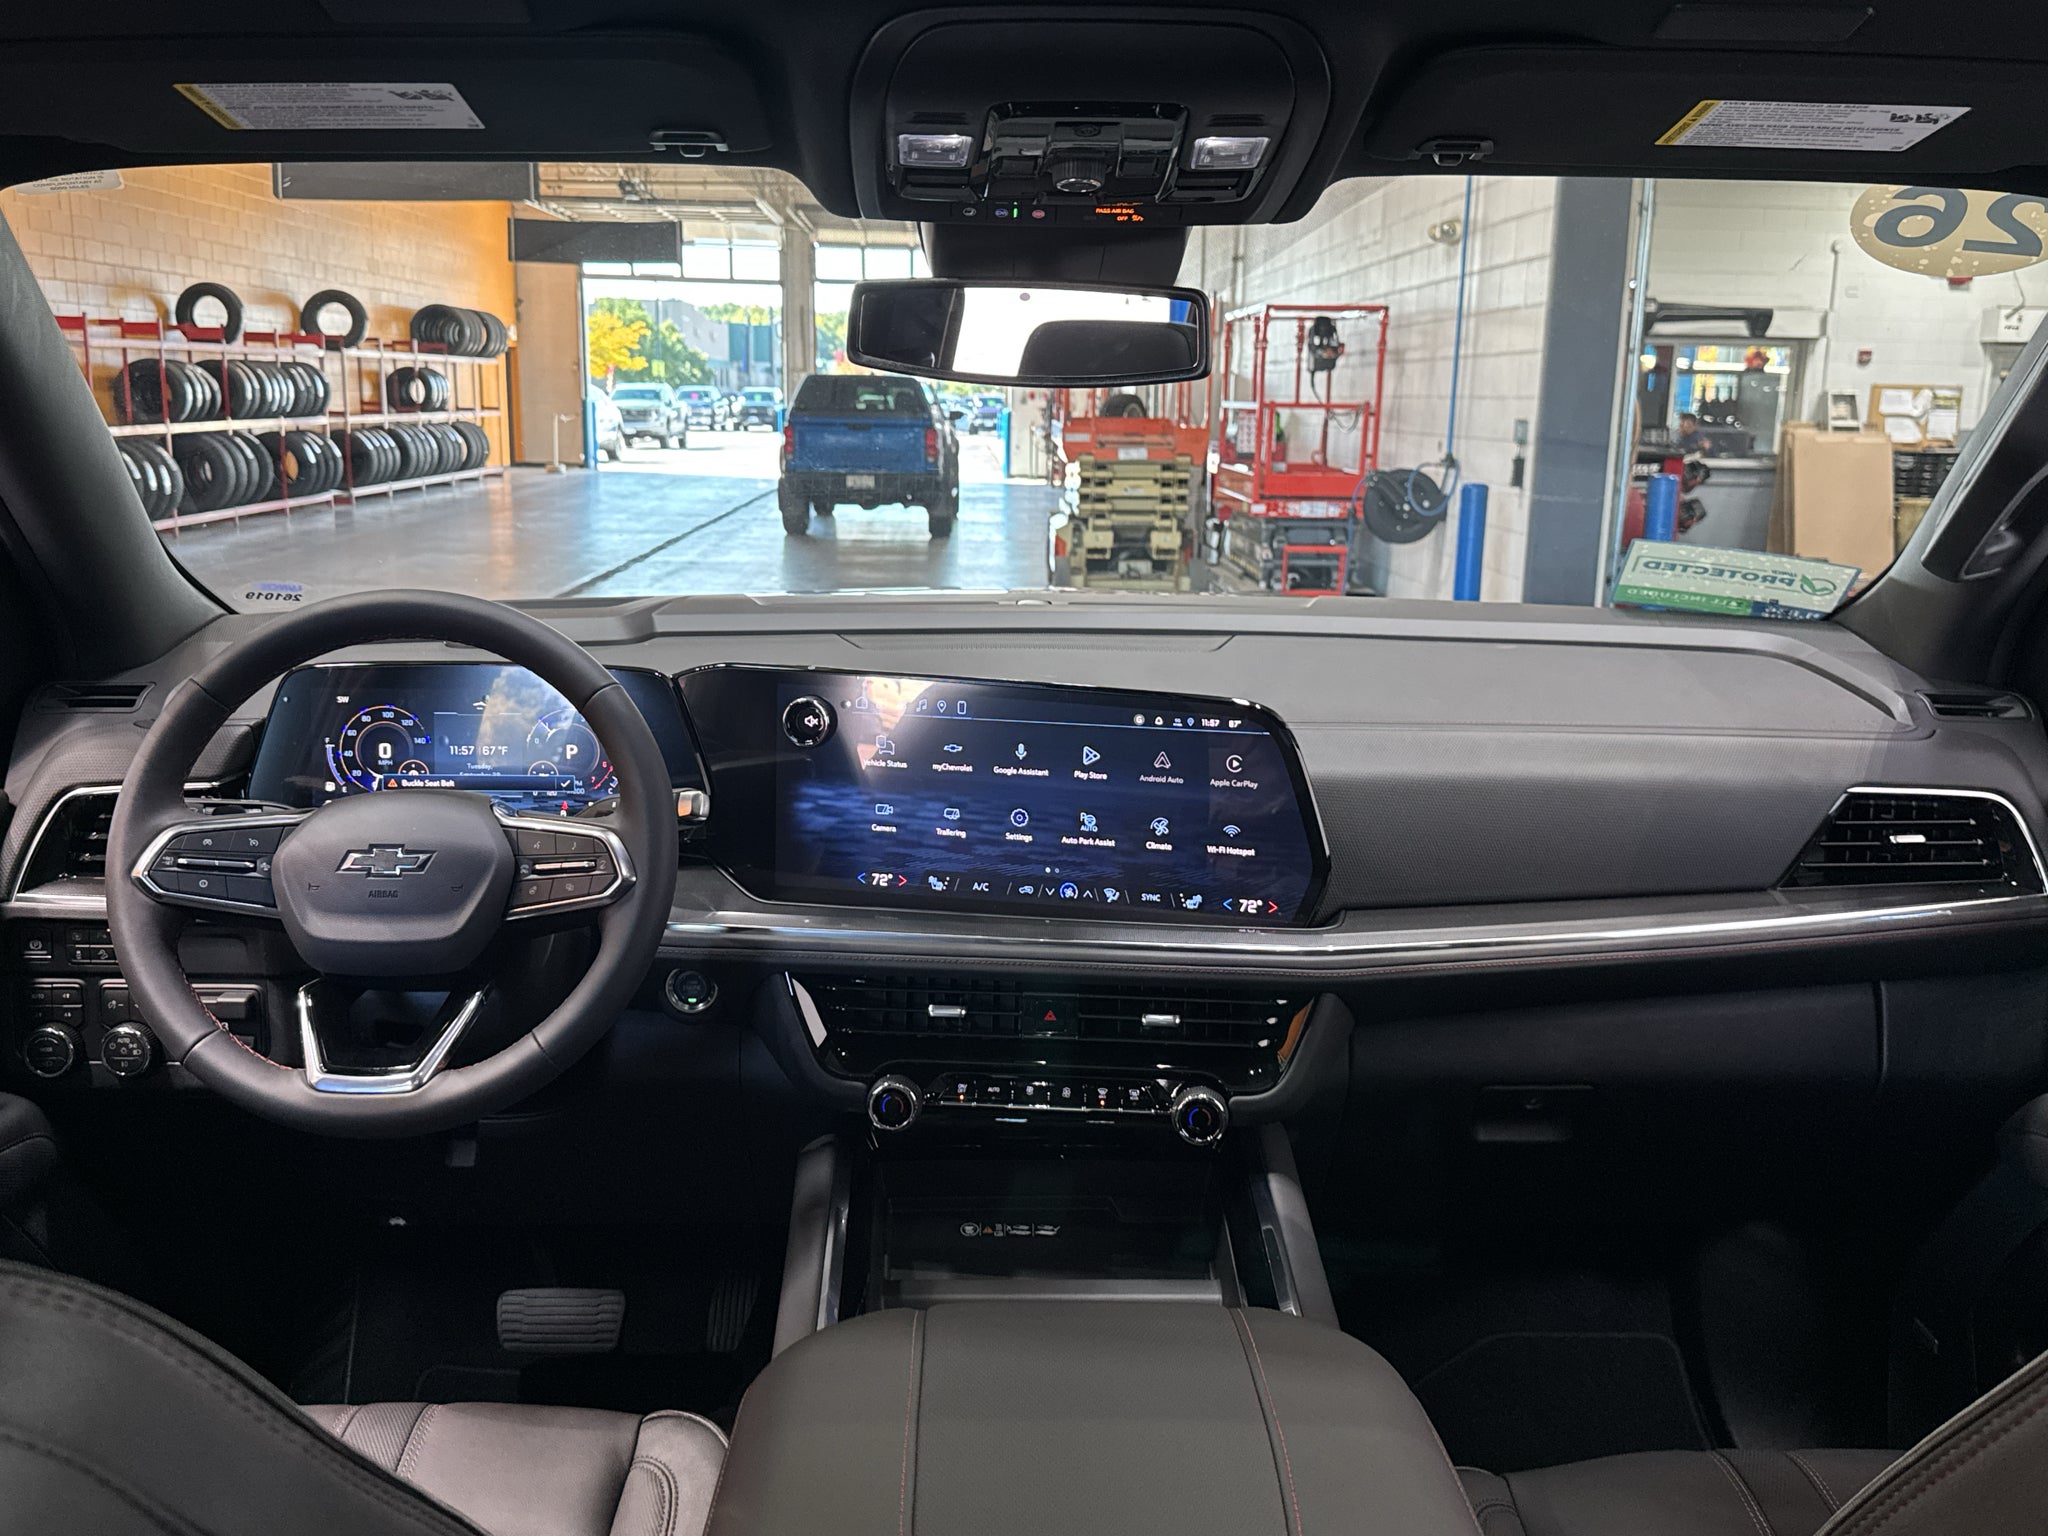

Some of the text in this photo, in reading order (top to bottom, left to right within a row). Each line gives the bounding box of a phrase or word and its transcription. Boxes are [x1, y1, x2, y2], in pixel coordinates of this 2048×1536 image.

[1202, 718, 1220, 727] 11:57
[378, 743, 392, 759] 0
[449, 745, 475, 756] 11:57
[482, 745, 496, 756] 67
[566, 744, 578, 760] P
[863, 759, 908, 769] Vehicle Status
[932, 763, 973, 773] myChevrolet
[993, 765, 1049, 777] Google Assistant
[1074, 770, 1108, 781] Play Store
[401, 779, 455, 788] Buckle Seat Belt
[1139, 774, 1184, 784] Android Auto
[1210, 778, 1258, 790] Apple CarPlay
[871, 823, 897, 833] Camera
[935, 827, 967, 839] Trailering
[1005, 832, 1033, 843] Settings
[1061, 836, 1116, 847] Auto Park Assist
[1145, 841, 1173, 851] Climate
[1226, 846, 1256, 857] Hotspot
[972, 882, 990, 892] A/C
[368, 890, 399, 898] AIRBAG
[1141, 893, 1161, 902] SYNC
